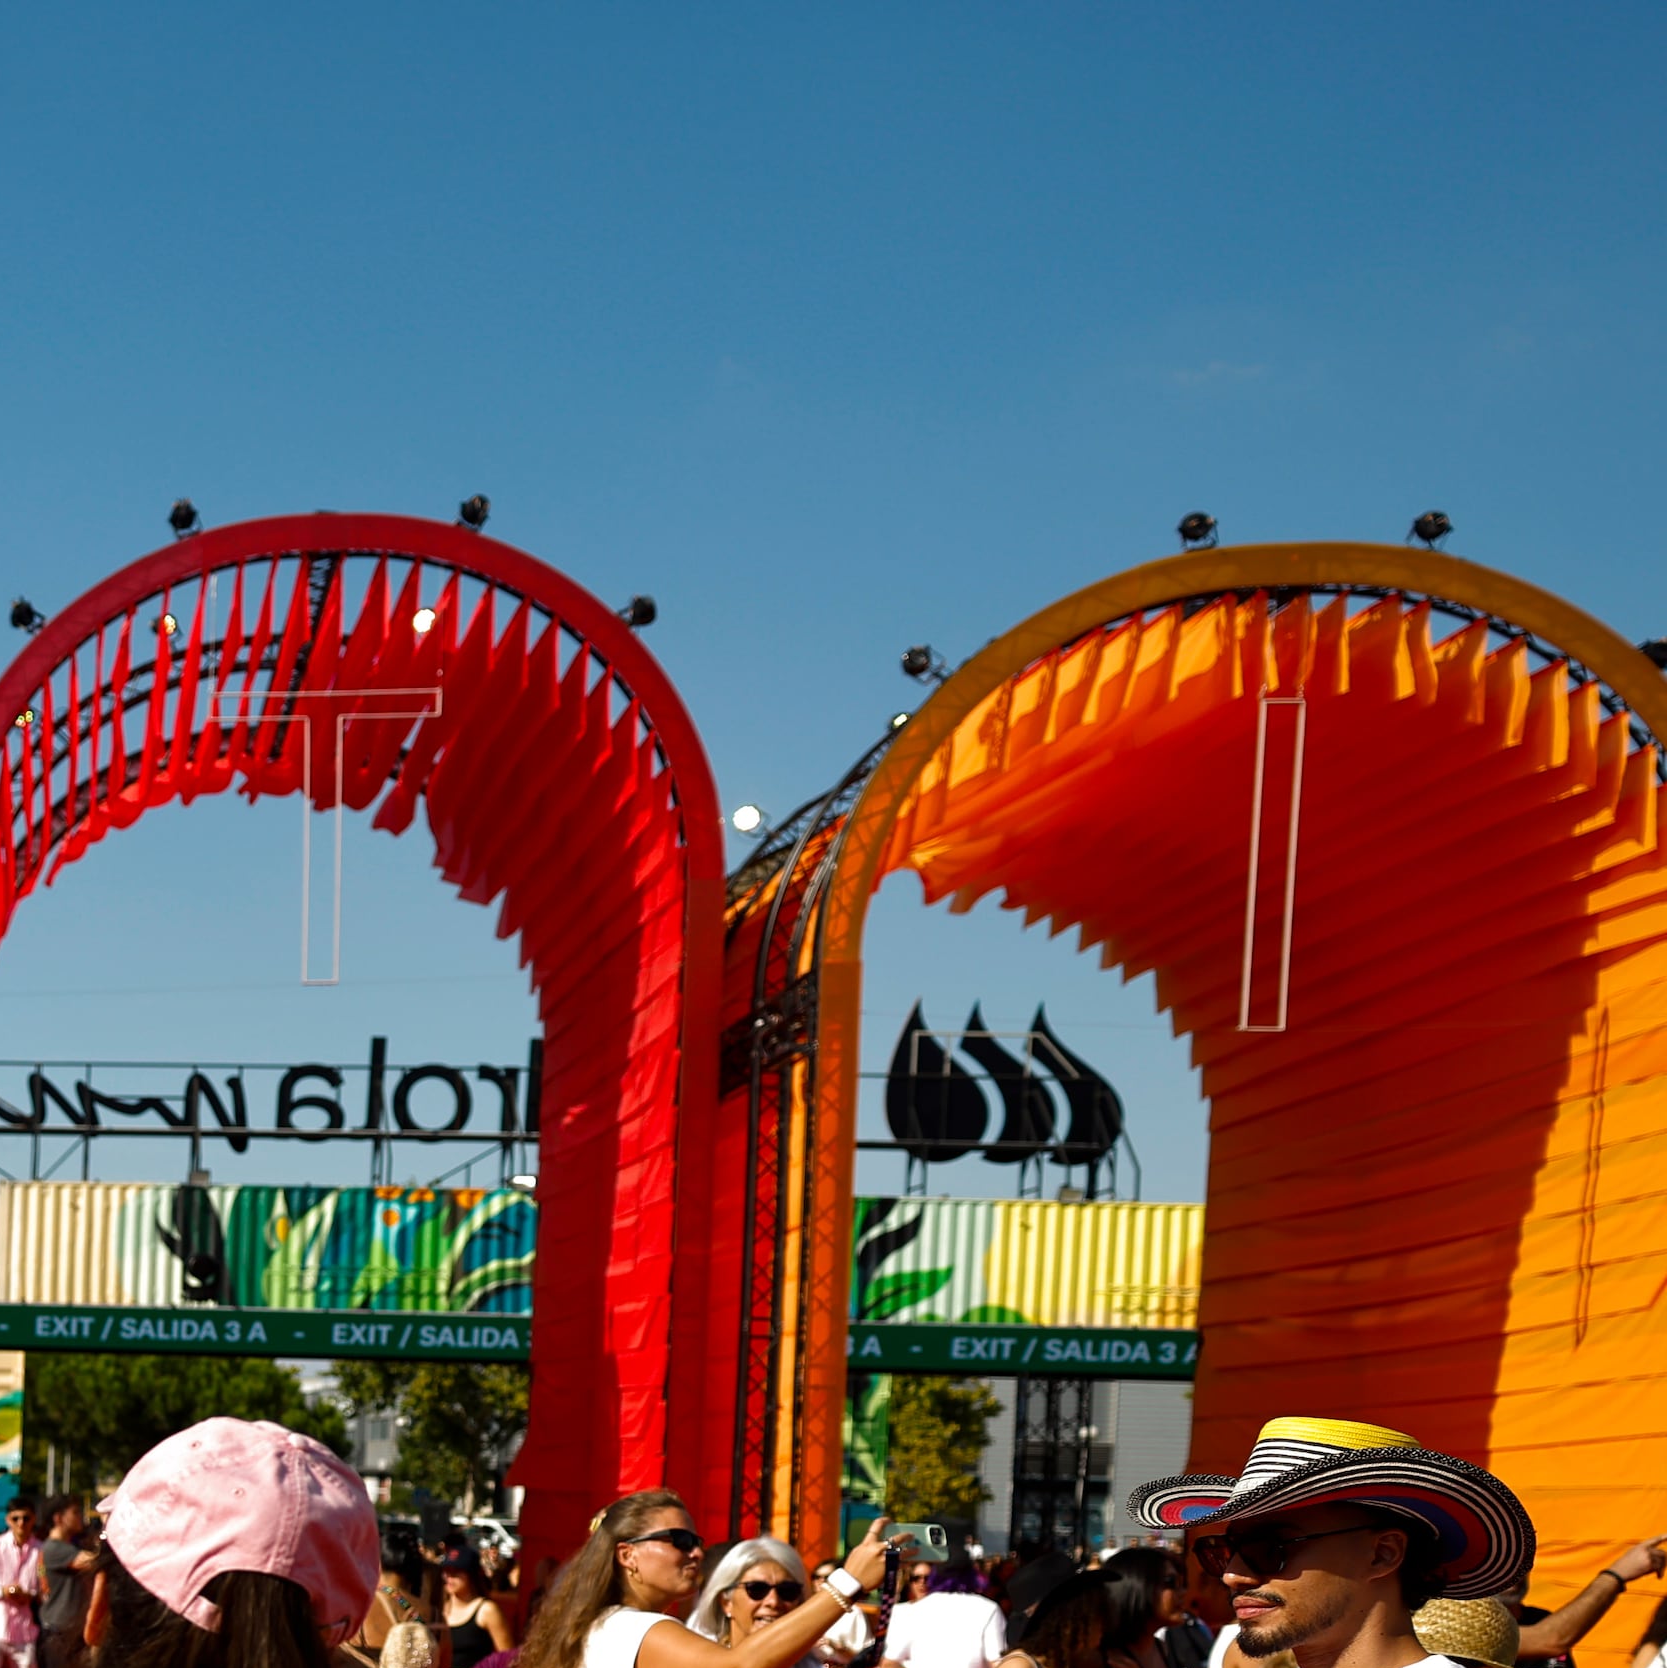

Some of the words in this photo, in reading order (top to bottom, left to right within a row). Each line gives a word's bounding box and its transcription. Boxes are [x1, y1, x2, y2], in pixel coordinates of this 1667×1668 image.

[209, 686, 443, 986] T
[34, 1315, 95, 1338] EXIT
[100, 1316, 114, 1341] /
[120, 1317, 217, 1341] SALIDA
[224, 1320, 241, 1342] 3
[247, 1320, 267, 1342] A
[332, 1323, 393, 1345] EXIT
[398, 1324, 413, 1349] /
[419, 1326, 520, 1348] SALIDA
[860, 1335, 883, 1358] A
[951, 1336, 1017, 1360] EXIT
[1021, 1336, 1038, 1364] /
[1043, 1338, 1151, 1364] SALIDA
[1158, 1341, 1178, 1364] 3
